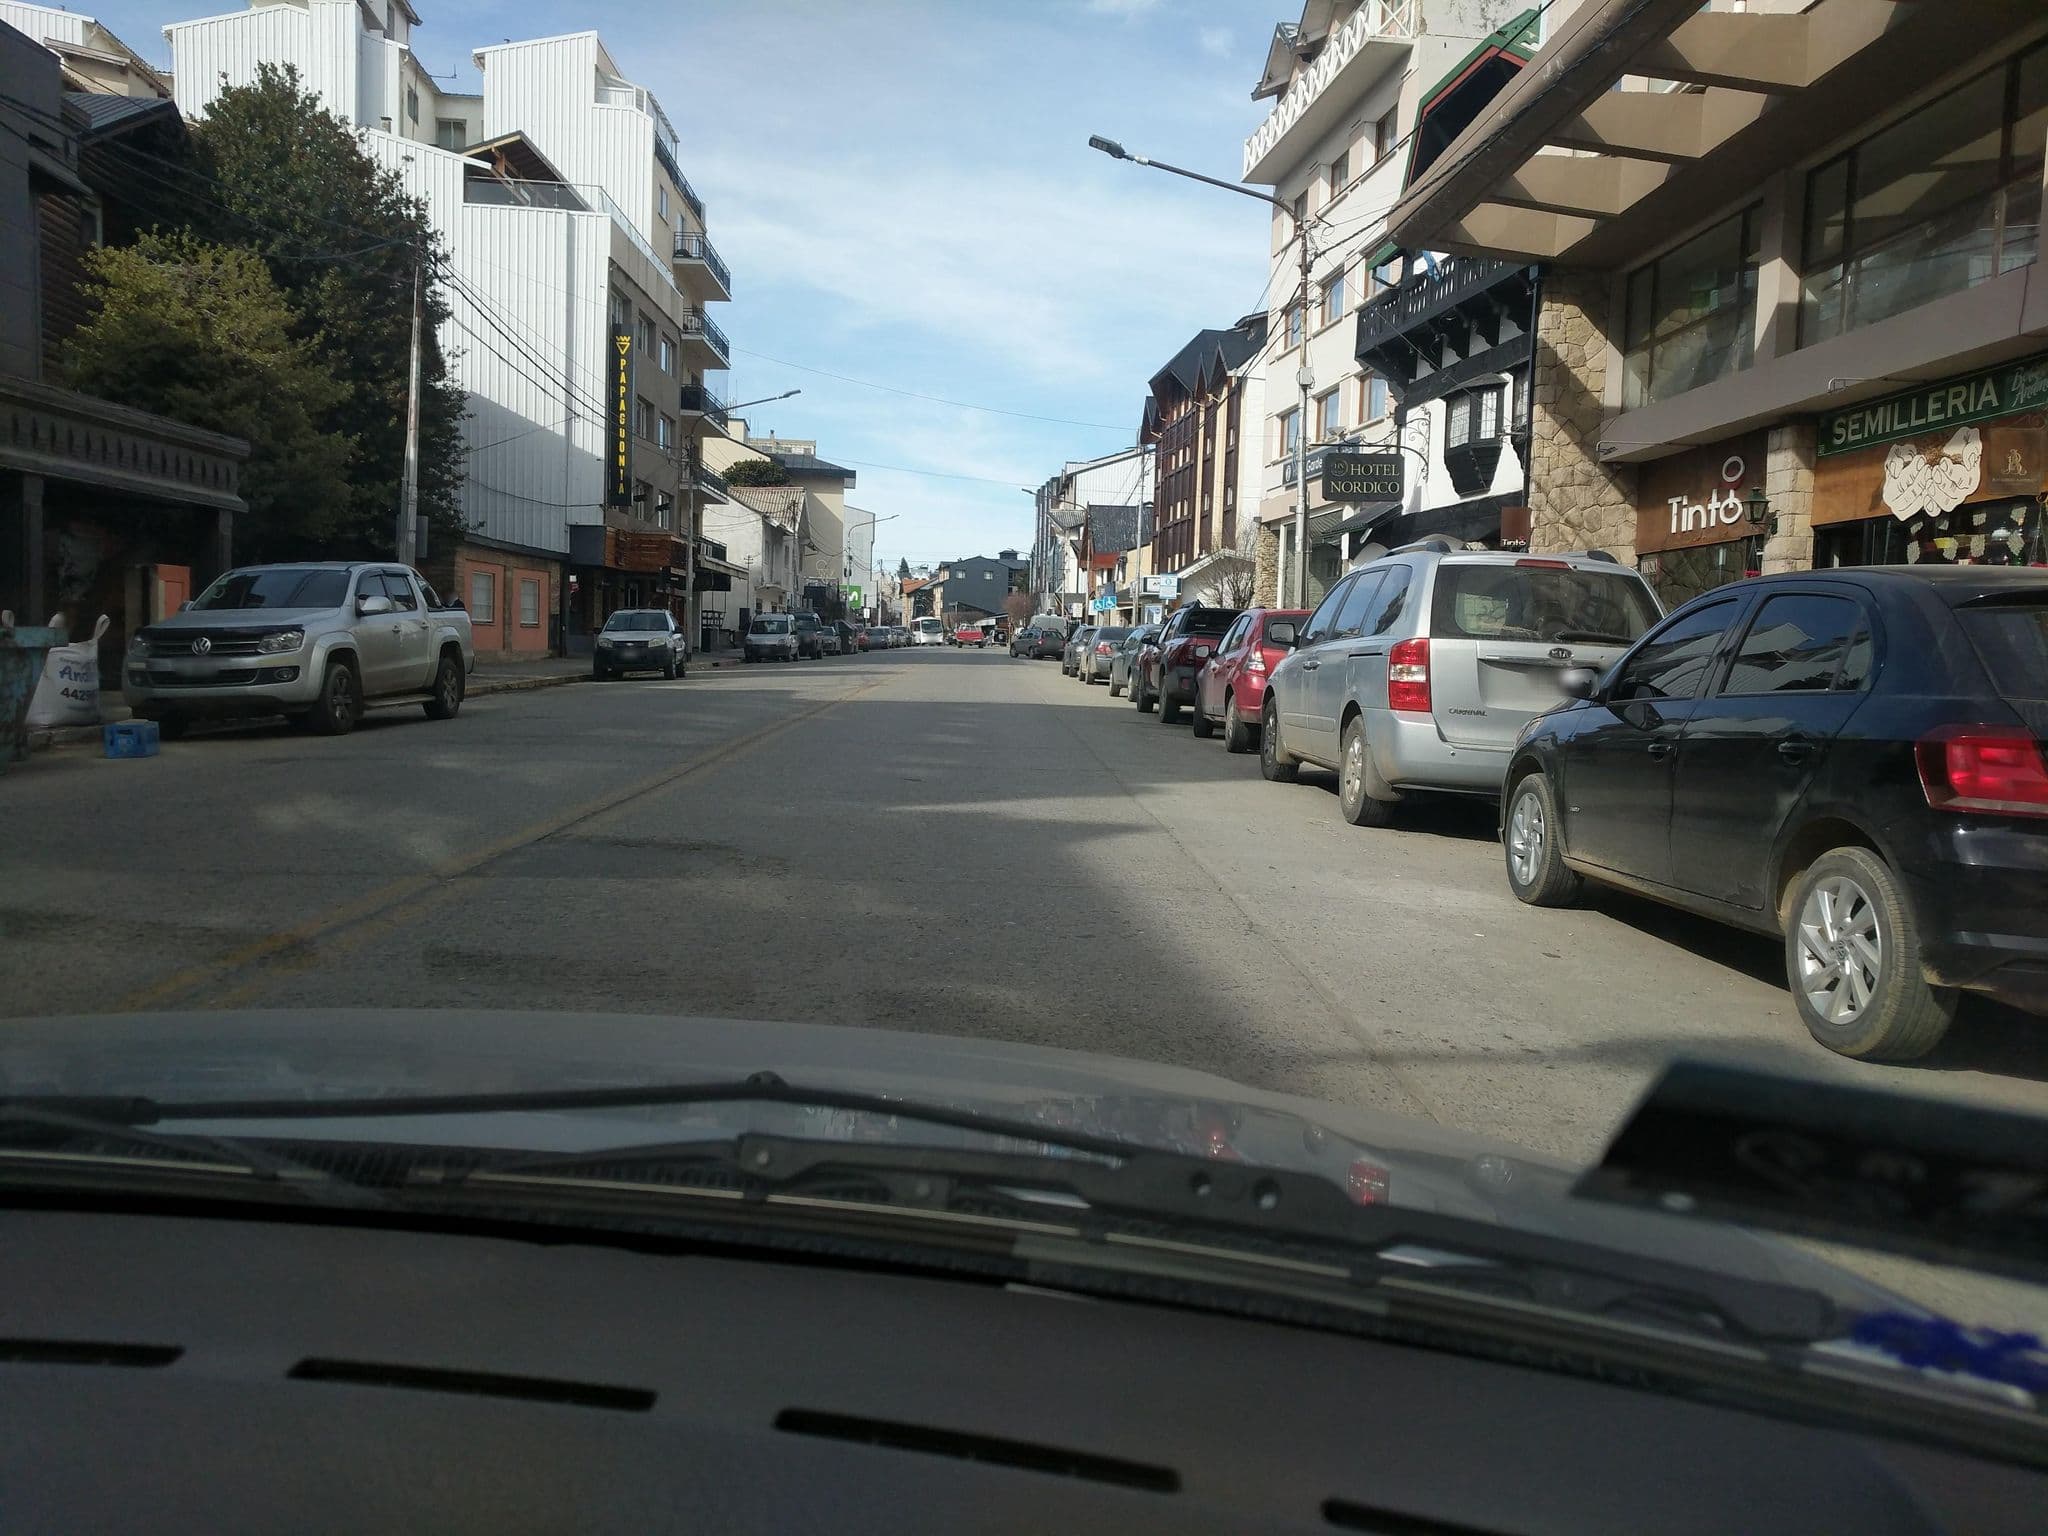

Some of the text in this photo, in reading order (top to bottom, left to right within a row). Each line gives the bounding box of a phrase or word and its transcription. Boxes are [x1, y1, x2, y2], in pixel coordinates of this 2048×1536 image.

[619, 358, 627, 494] PAPAGUONIA
[1832, 377, 1999, 446] SEMILLERIA
[1306, 456, 1323, 473] Garde
[1350, 463, 1400, 476] HOTEL
[1330, 481, 1400, 494] NORDICO
[1667, 488, 1743, 534] Tinto
